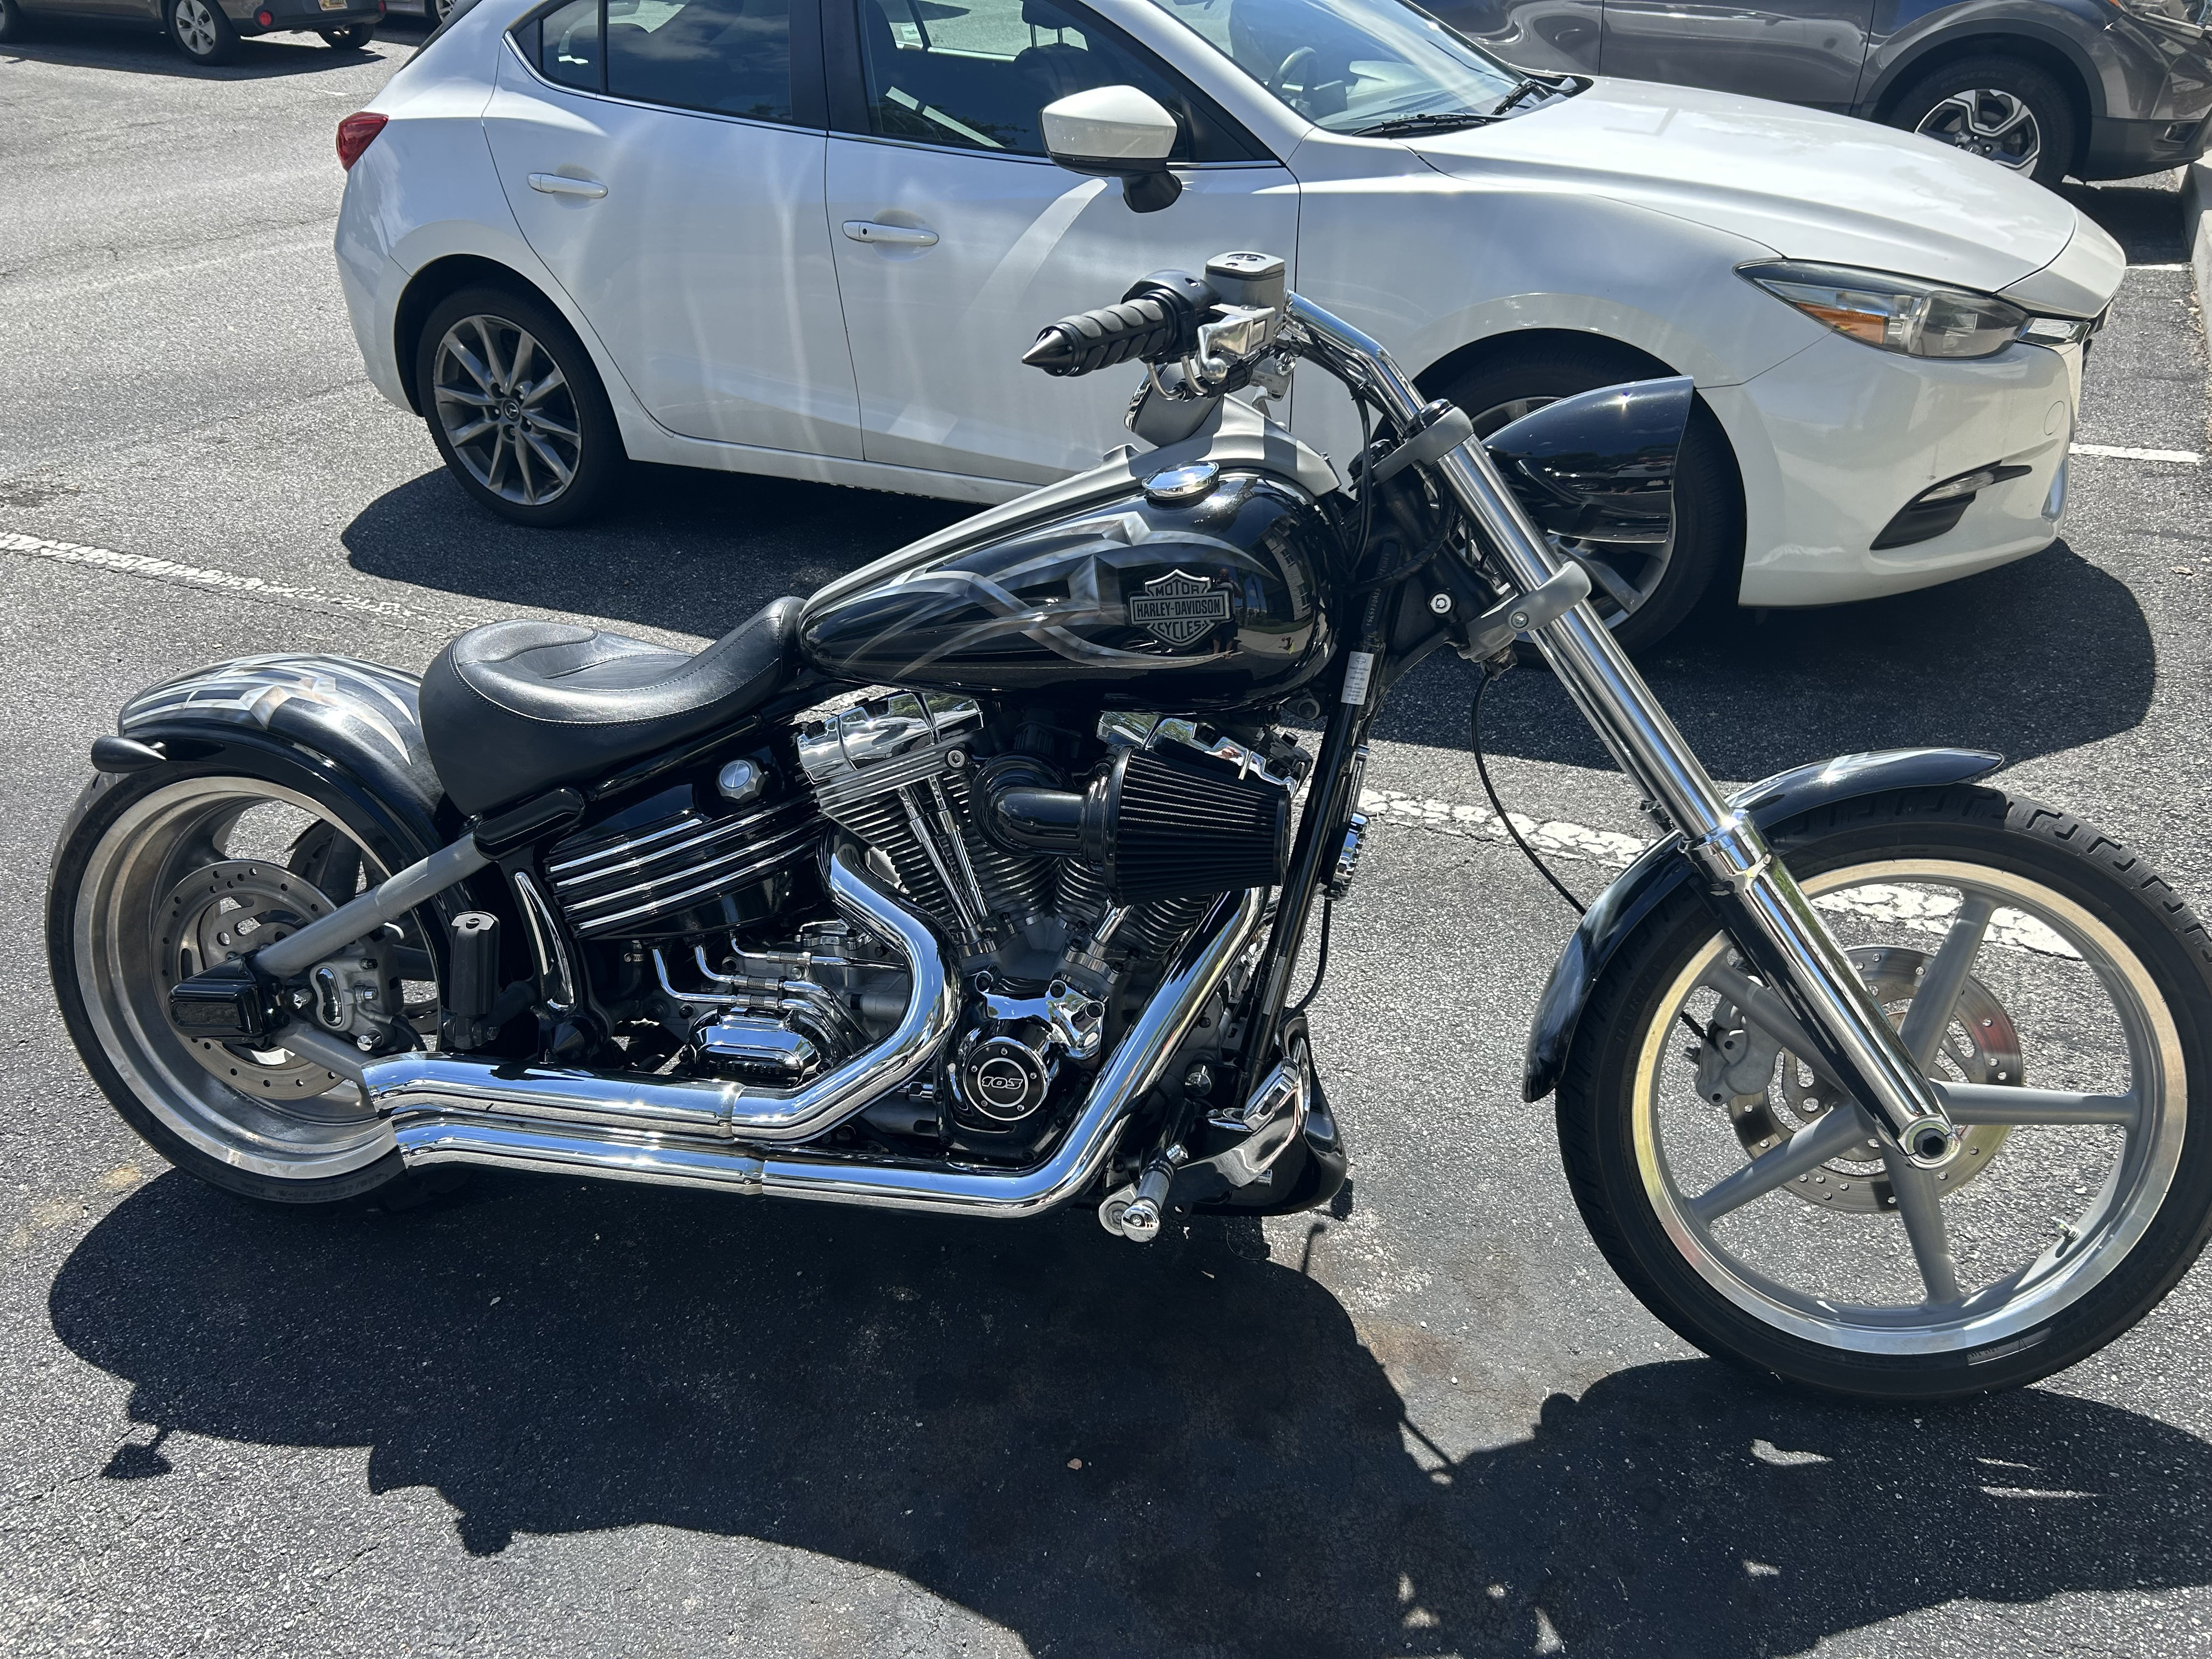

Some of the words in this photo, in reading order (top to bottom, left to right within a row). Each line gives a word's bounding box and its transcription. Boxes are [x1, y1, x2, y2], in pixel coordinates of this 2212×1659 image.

[1155, 579, 1199, 596] MOTOR
[1137, 599, 1221, 618] HARLEY-DAVIDSON
[1157, 620, 1200, 640] CYCLES
